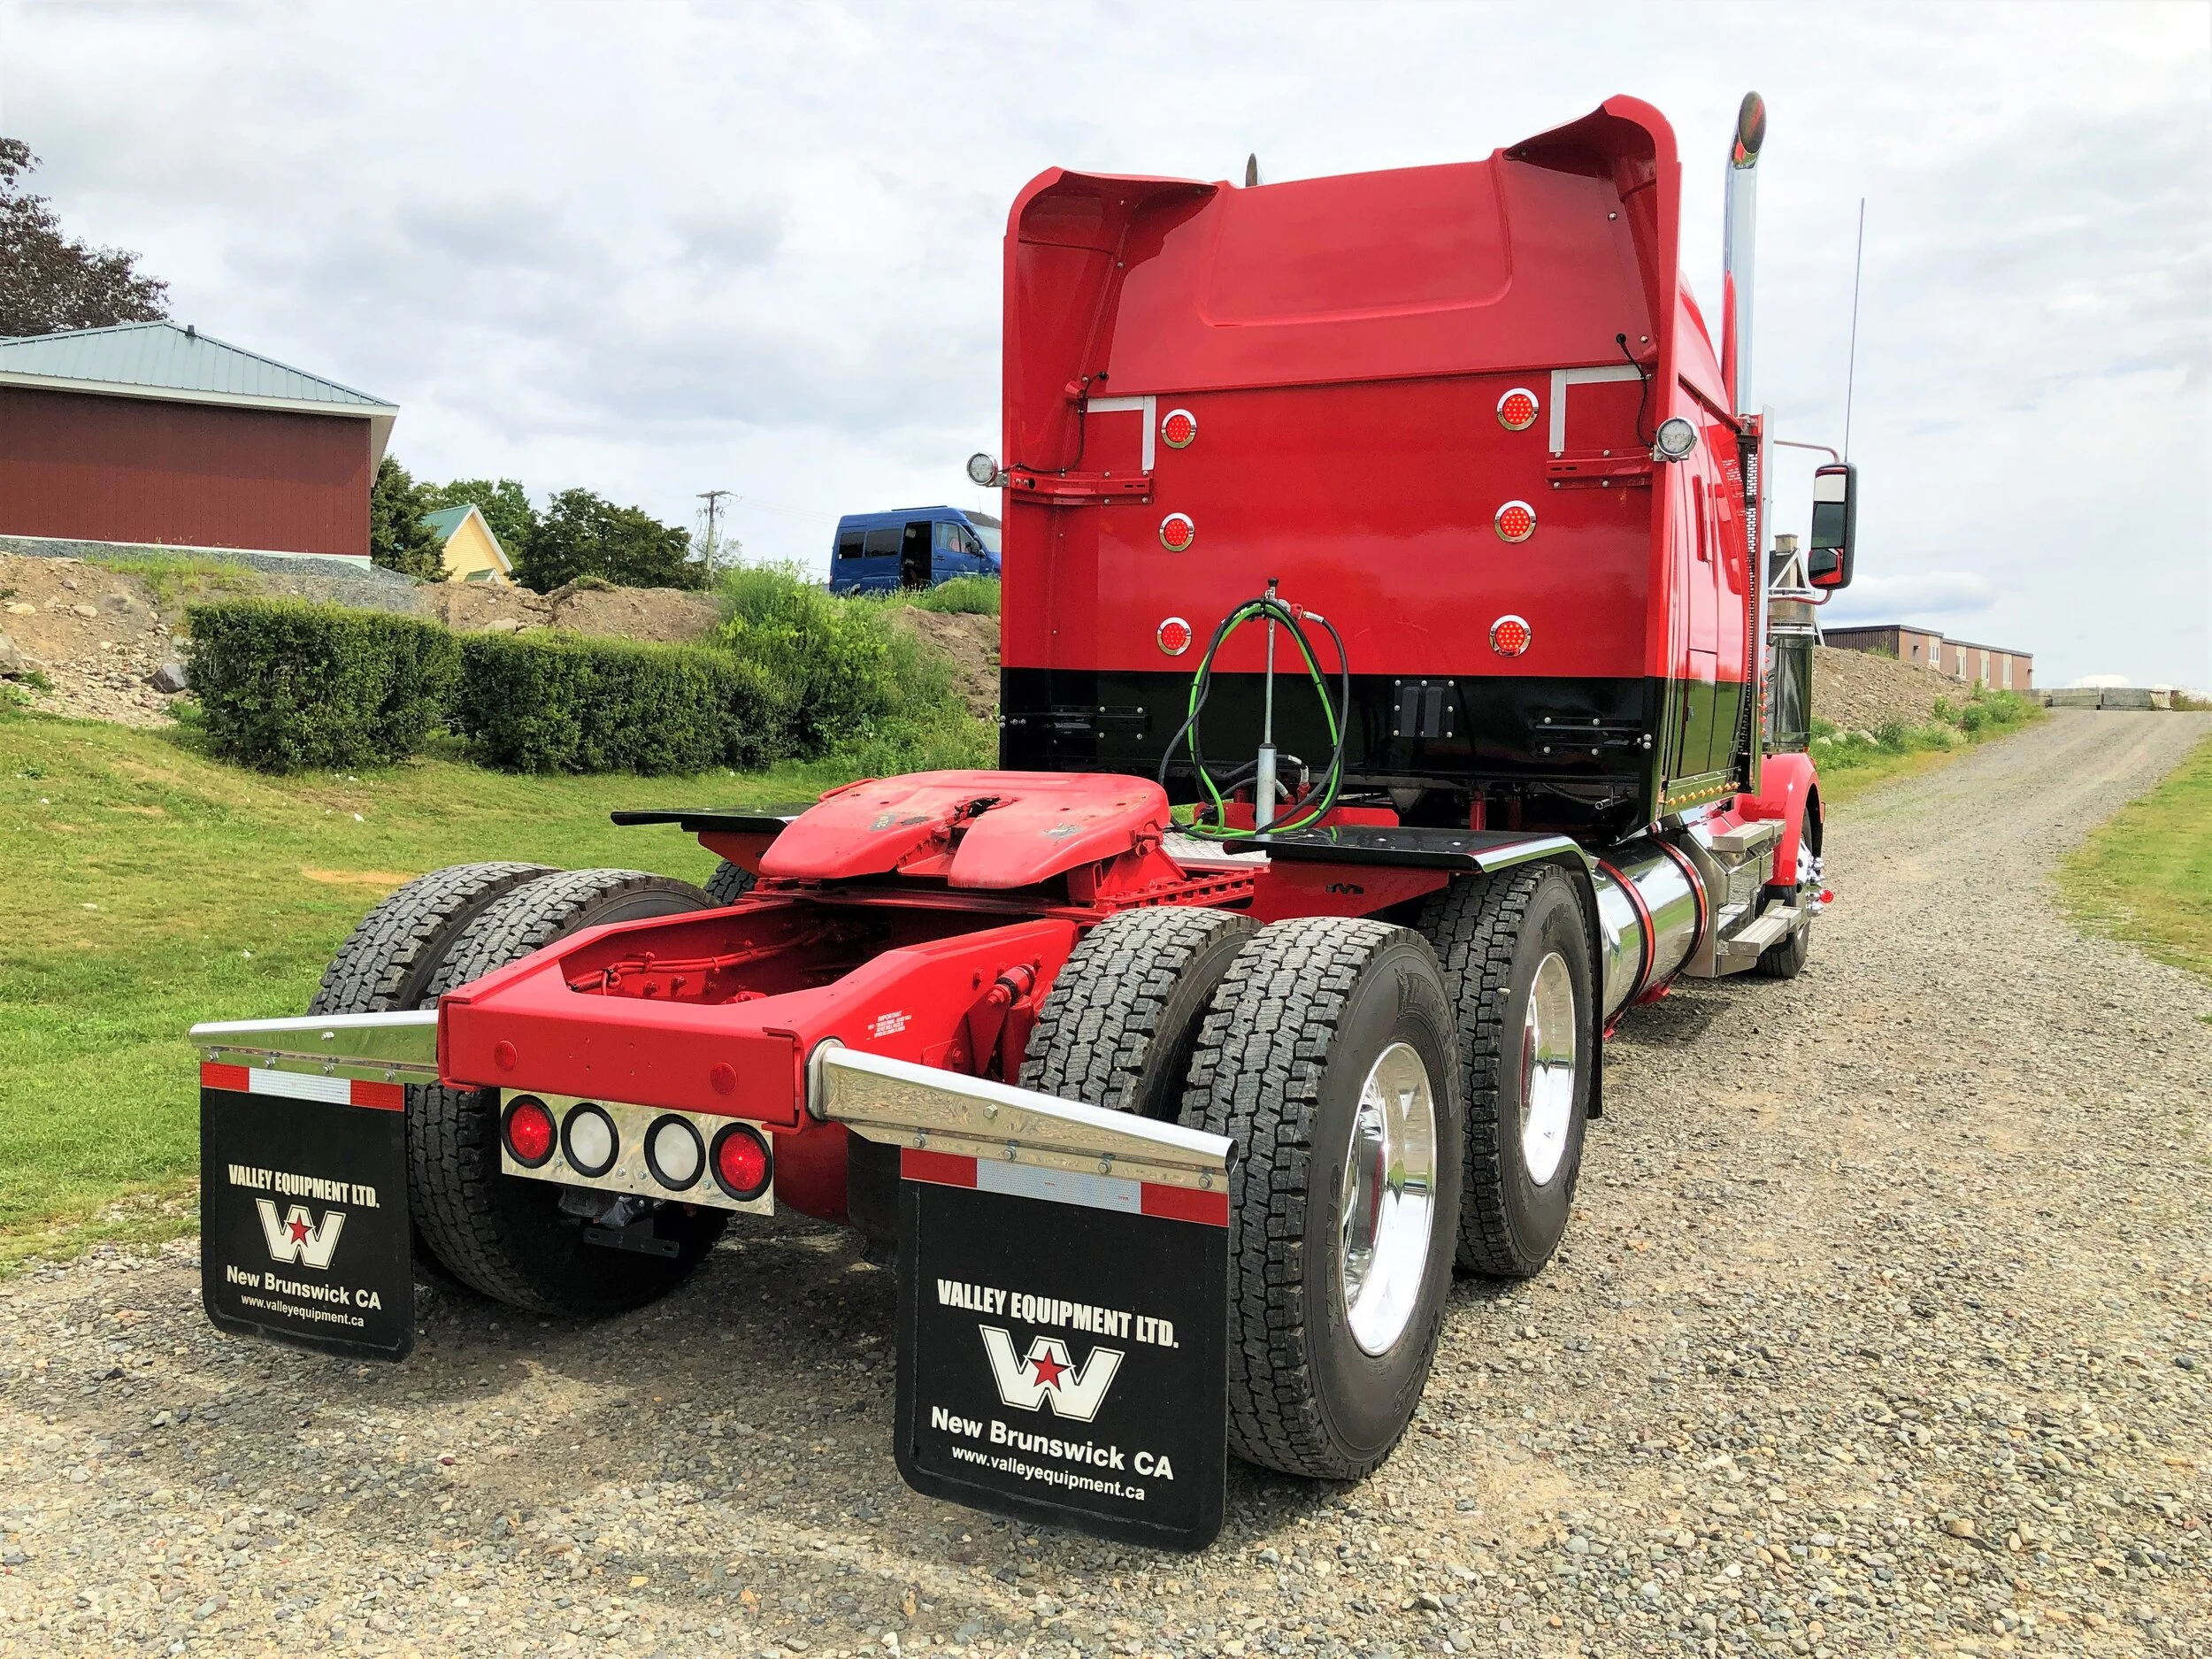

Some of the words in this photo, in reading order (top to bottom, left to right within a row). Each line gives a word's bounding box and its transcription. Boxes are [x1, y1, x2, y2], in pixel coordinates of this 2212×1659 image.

[228, 1164, 273, 1190] VALLEY
[275, 1171, 349, 1203] EQUIPMENT
[352, 1184, 380, 1209] LTD.
[227, 1264, 260, 1287] New
[265, 1272, 349, 1305] Brunswick
[355, 1289, 381, 1310] CA
[241, 1294, 365, 1327] www.valleyequipment.ca
[937, 1279, 1007, 1315] VALLEY
[1010, 1292, 1132, 1340] EQUIPMENT
[1135, 1315, 1179, 1349] LTD.
[931, 1406, 983, 1438] New
[990, 1420, 1125, 1471] Brunswick
[1133, 1451, 1174, 1480] CA
[952, 1446, 1146, 1501] www.valleyequipment.ca
